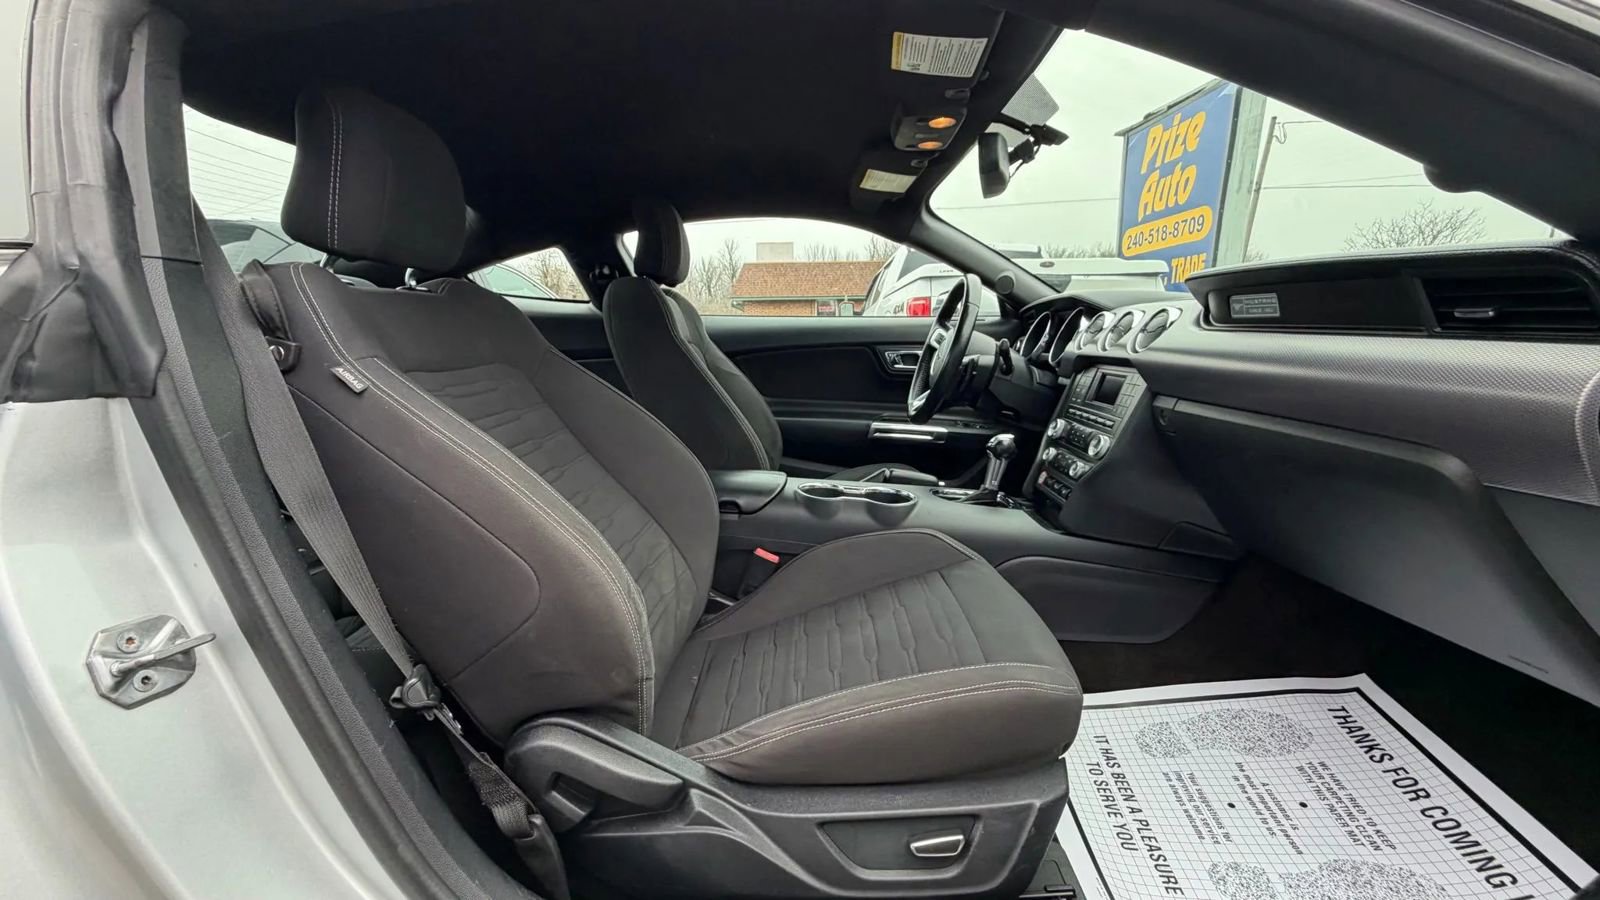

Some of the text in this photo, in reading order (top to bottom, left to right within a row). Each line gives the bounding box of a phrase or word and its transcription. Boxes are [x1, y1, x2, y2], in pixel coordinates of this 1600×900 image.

[1141, 111, 1206, 174] Prize
[1138, 162, 1196, 222] Auto
[1126, 214, 1205, 250] 240-518-8709
[1171, 252, 1207, 284] TRADE
[334, 367, 364, 389] AIRBAG
[1086, 762, 1139, 851] TO SERVE YOU
[1093, 735, 1185, 896] IT HAS BEEN A PLEASURE
[1162, 772, 1173, 782] are
[1169, 784, 1186, 807] always
[1186, 772, 1233, 842] Your suggestions for
[1235, 762, 1303, 855] the most important person
[1237, 783, 1248, 794] the
[1245, 796, 1265, 816] world
[1259, 817, 1269, 825] to
[1265, 788, 1293, 821] customer
[1295, 766, 1366, 847] WITH THIS PAPER MAT
[1305, 761, 1383, 851] YOUR CARPETING CLEAN
[1317, 761, 1397, 850] WE HAVE TRIED TO KEEP
[1327, 705, 1518, 889] THANKS FOR COMING
[1193, 804, 1204, 816] our
[1200, 817, 1221, 844] service
